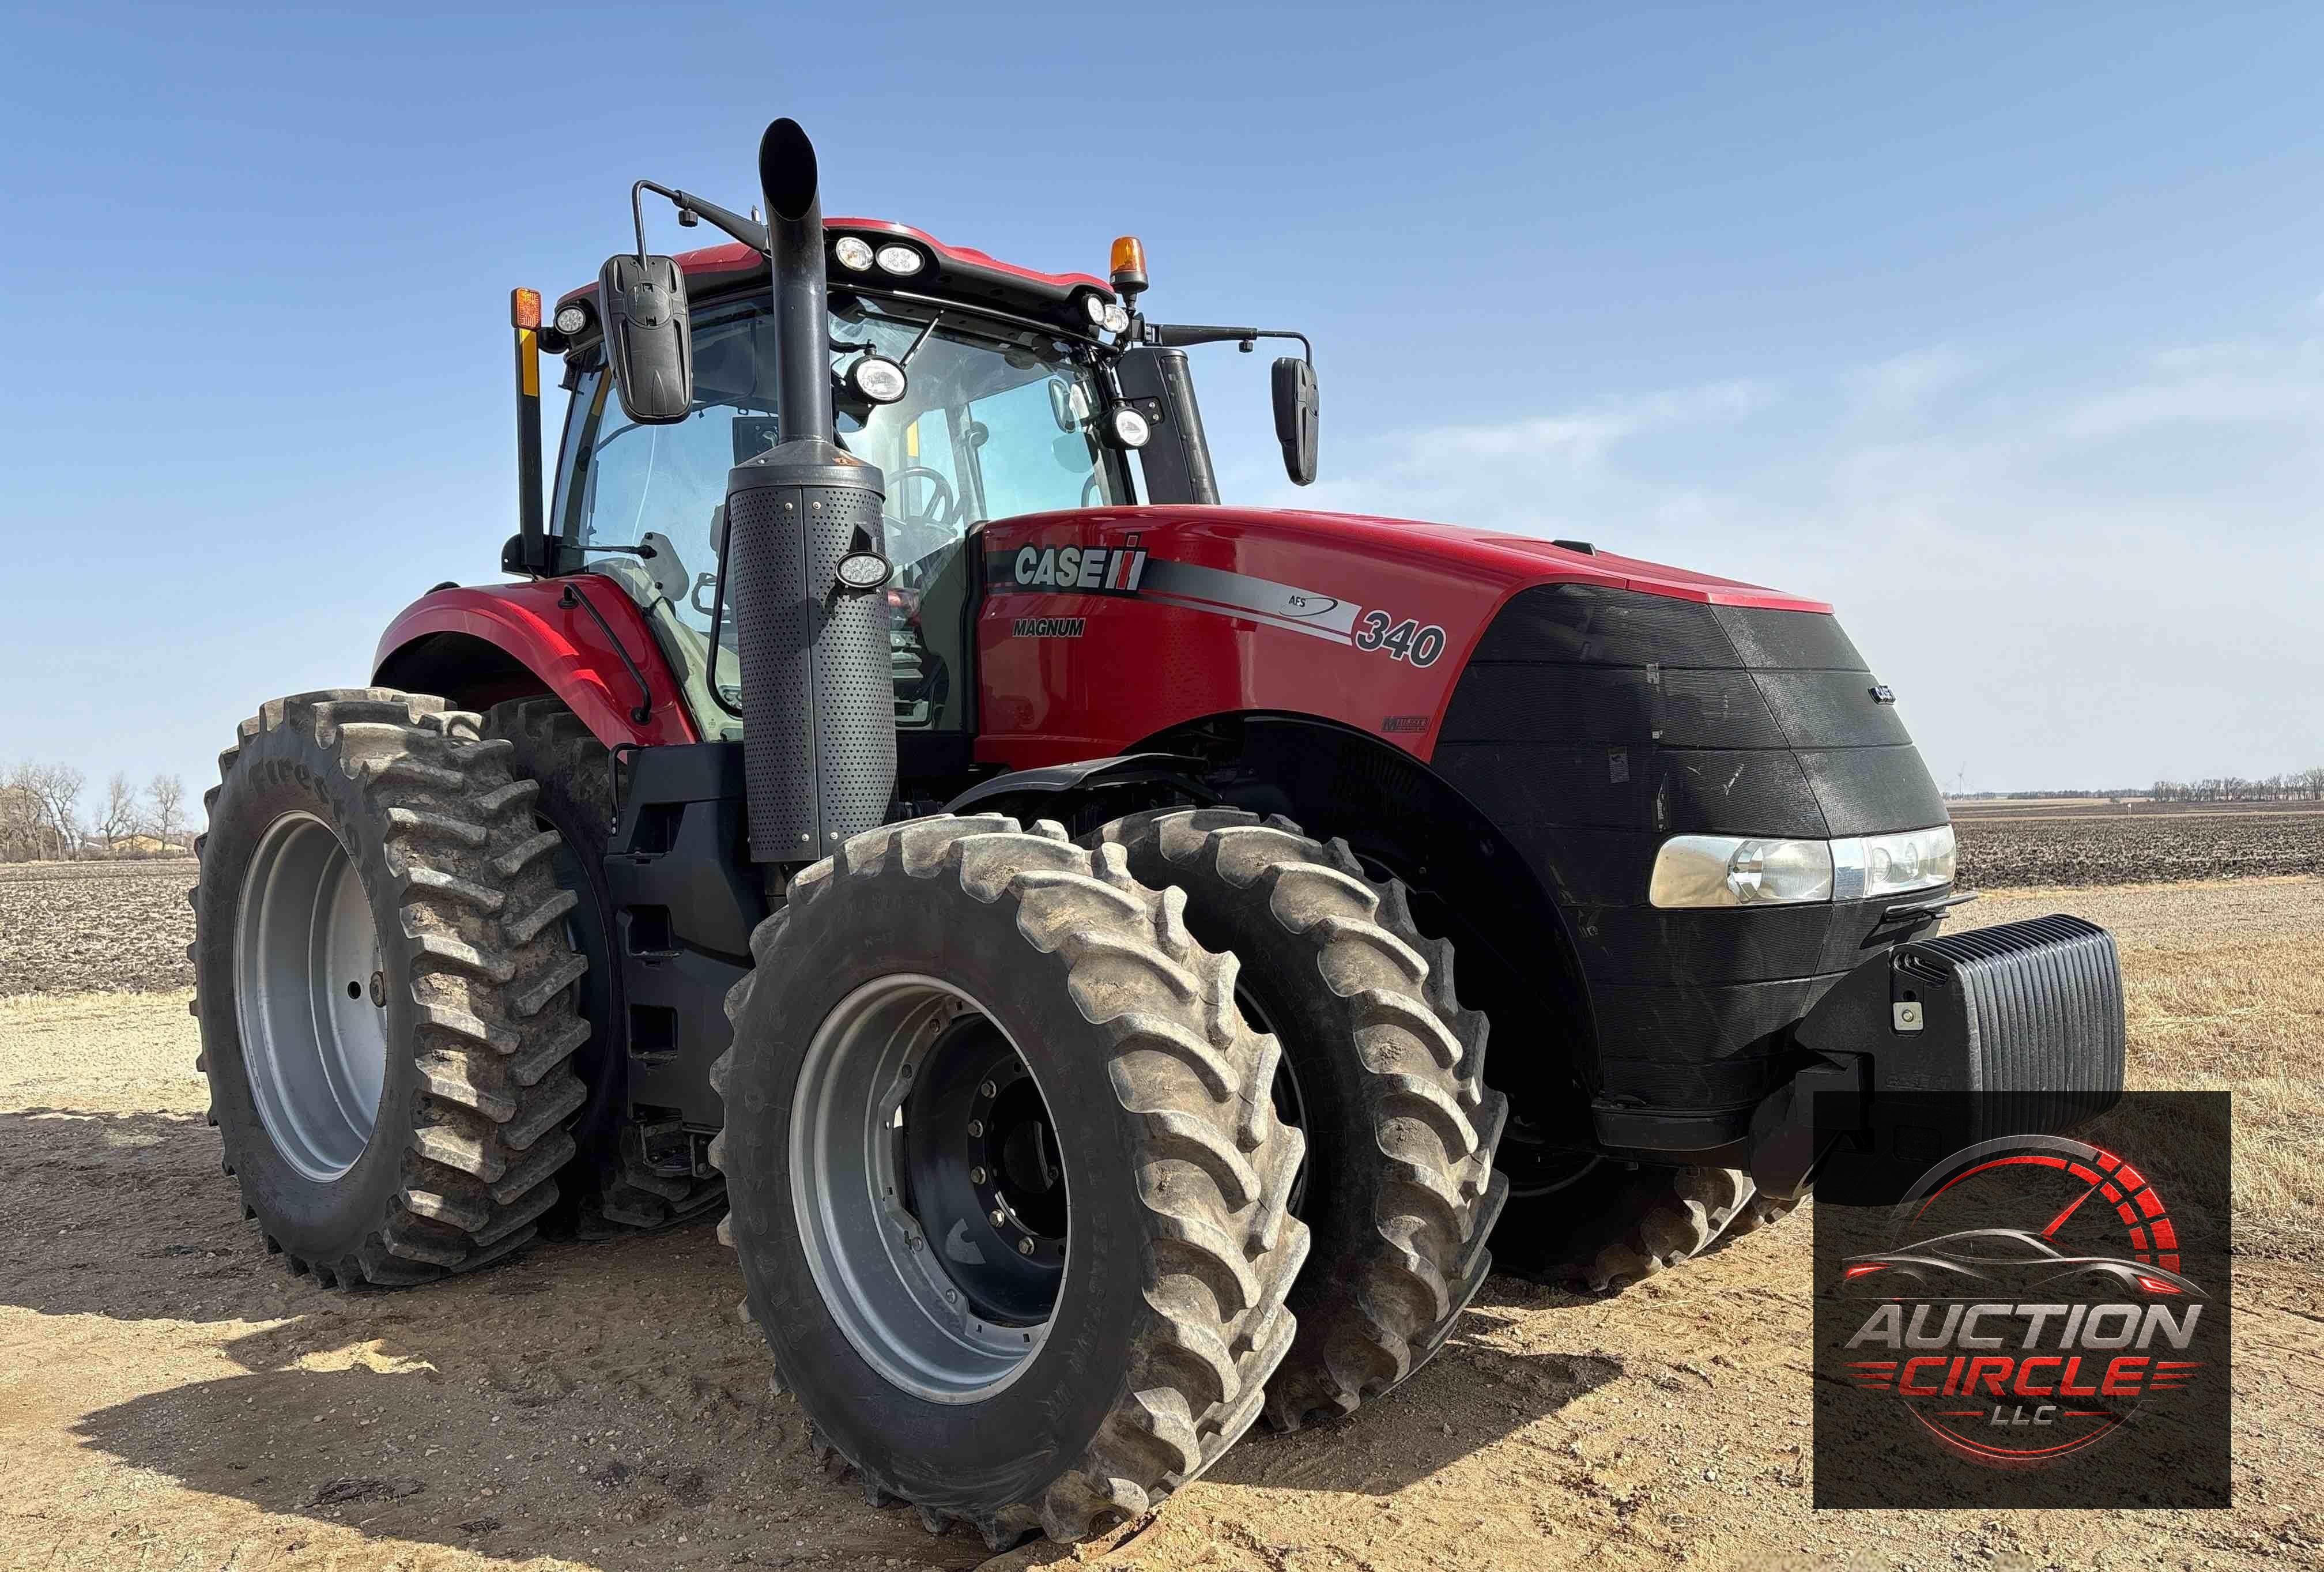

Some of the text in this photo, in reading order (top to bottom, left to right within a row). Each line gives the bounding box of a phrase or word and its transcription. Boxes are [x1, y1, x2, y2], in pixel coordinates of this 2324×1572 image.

[1288, 595, 1307, 608] AFS
[1012, 617, 1086, 638] MAGNUM
[1355, 609, 1447, 669] 340
